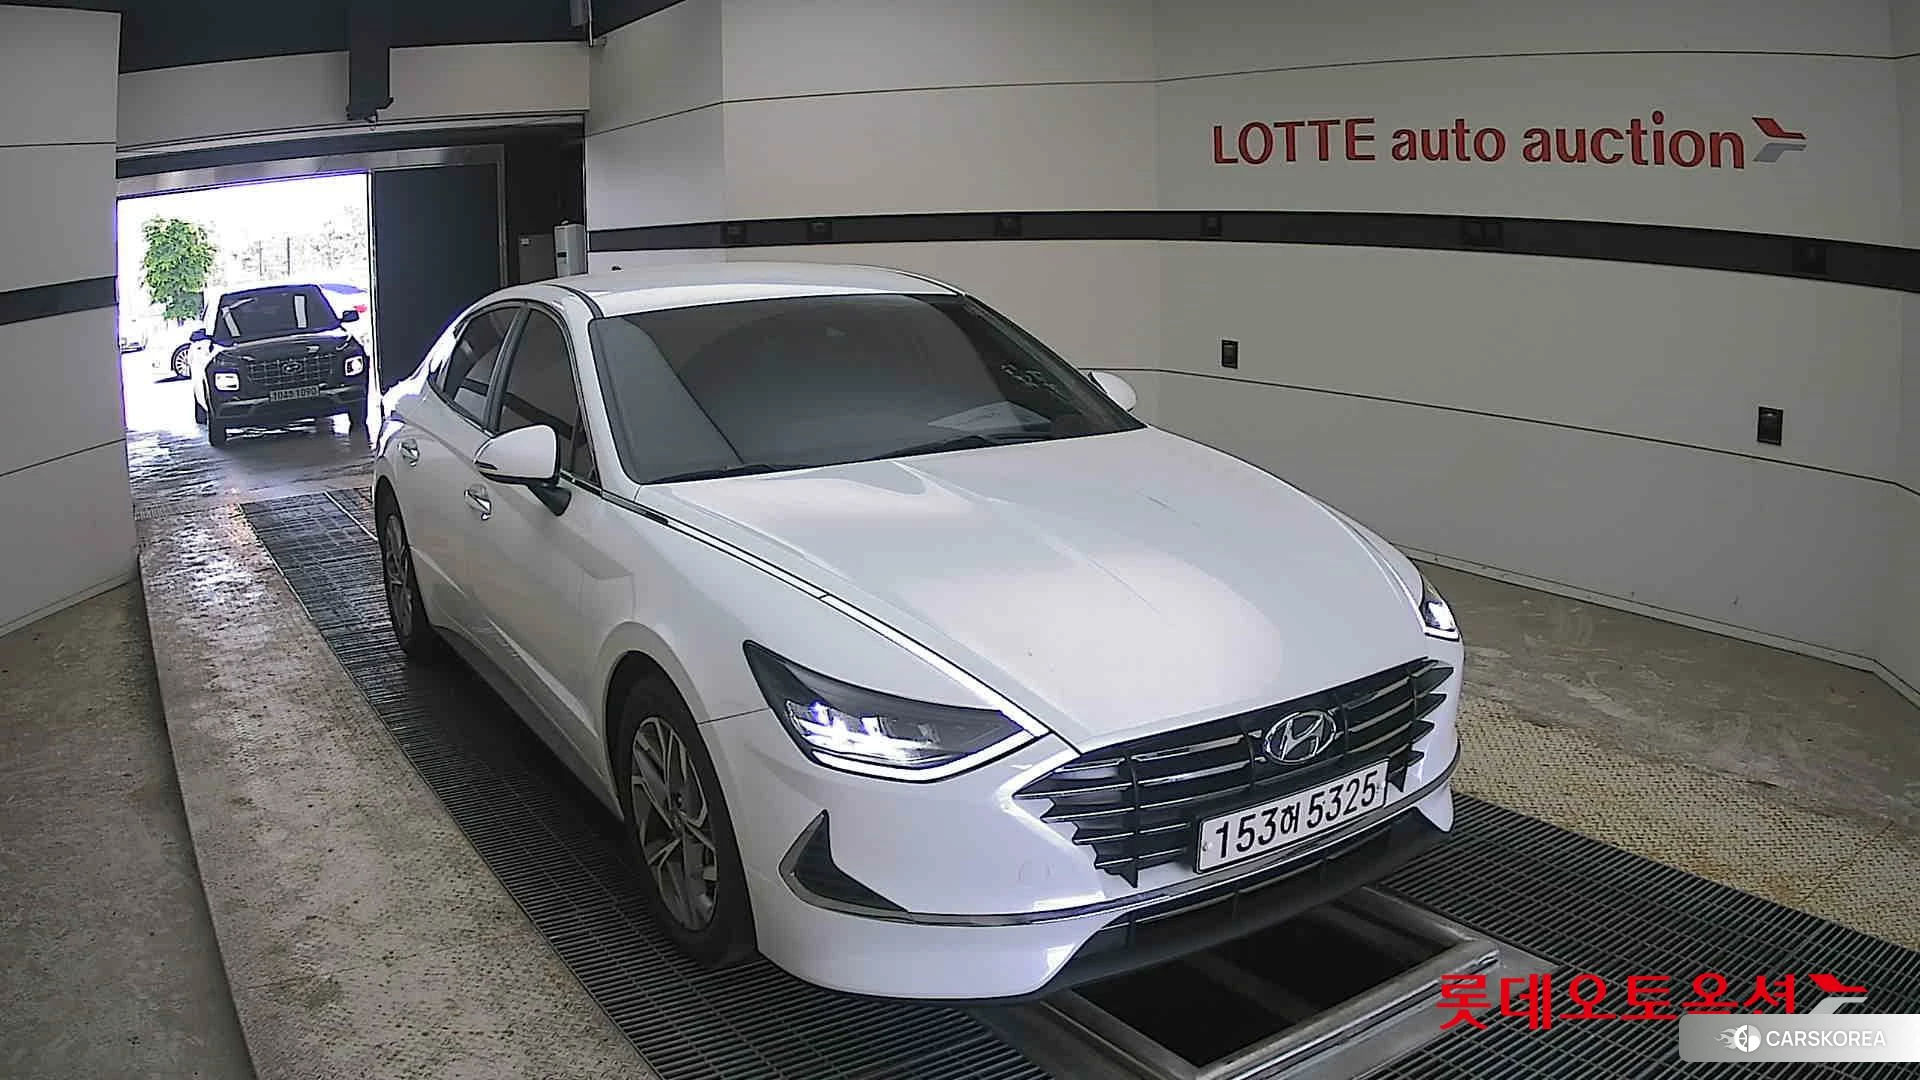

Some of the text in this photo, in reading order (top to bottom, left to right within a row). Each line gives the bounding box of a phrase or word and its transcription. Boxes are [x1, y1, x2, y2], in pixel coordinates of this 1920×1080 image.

[1213, 110, 1746, 169] LOTTE auto auction
[1215, 770, 1378, 859] 153허 5325
